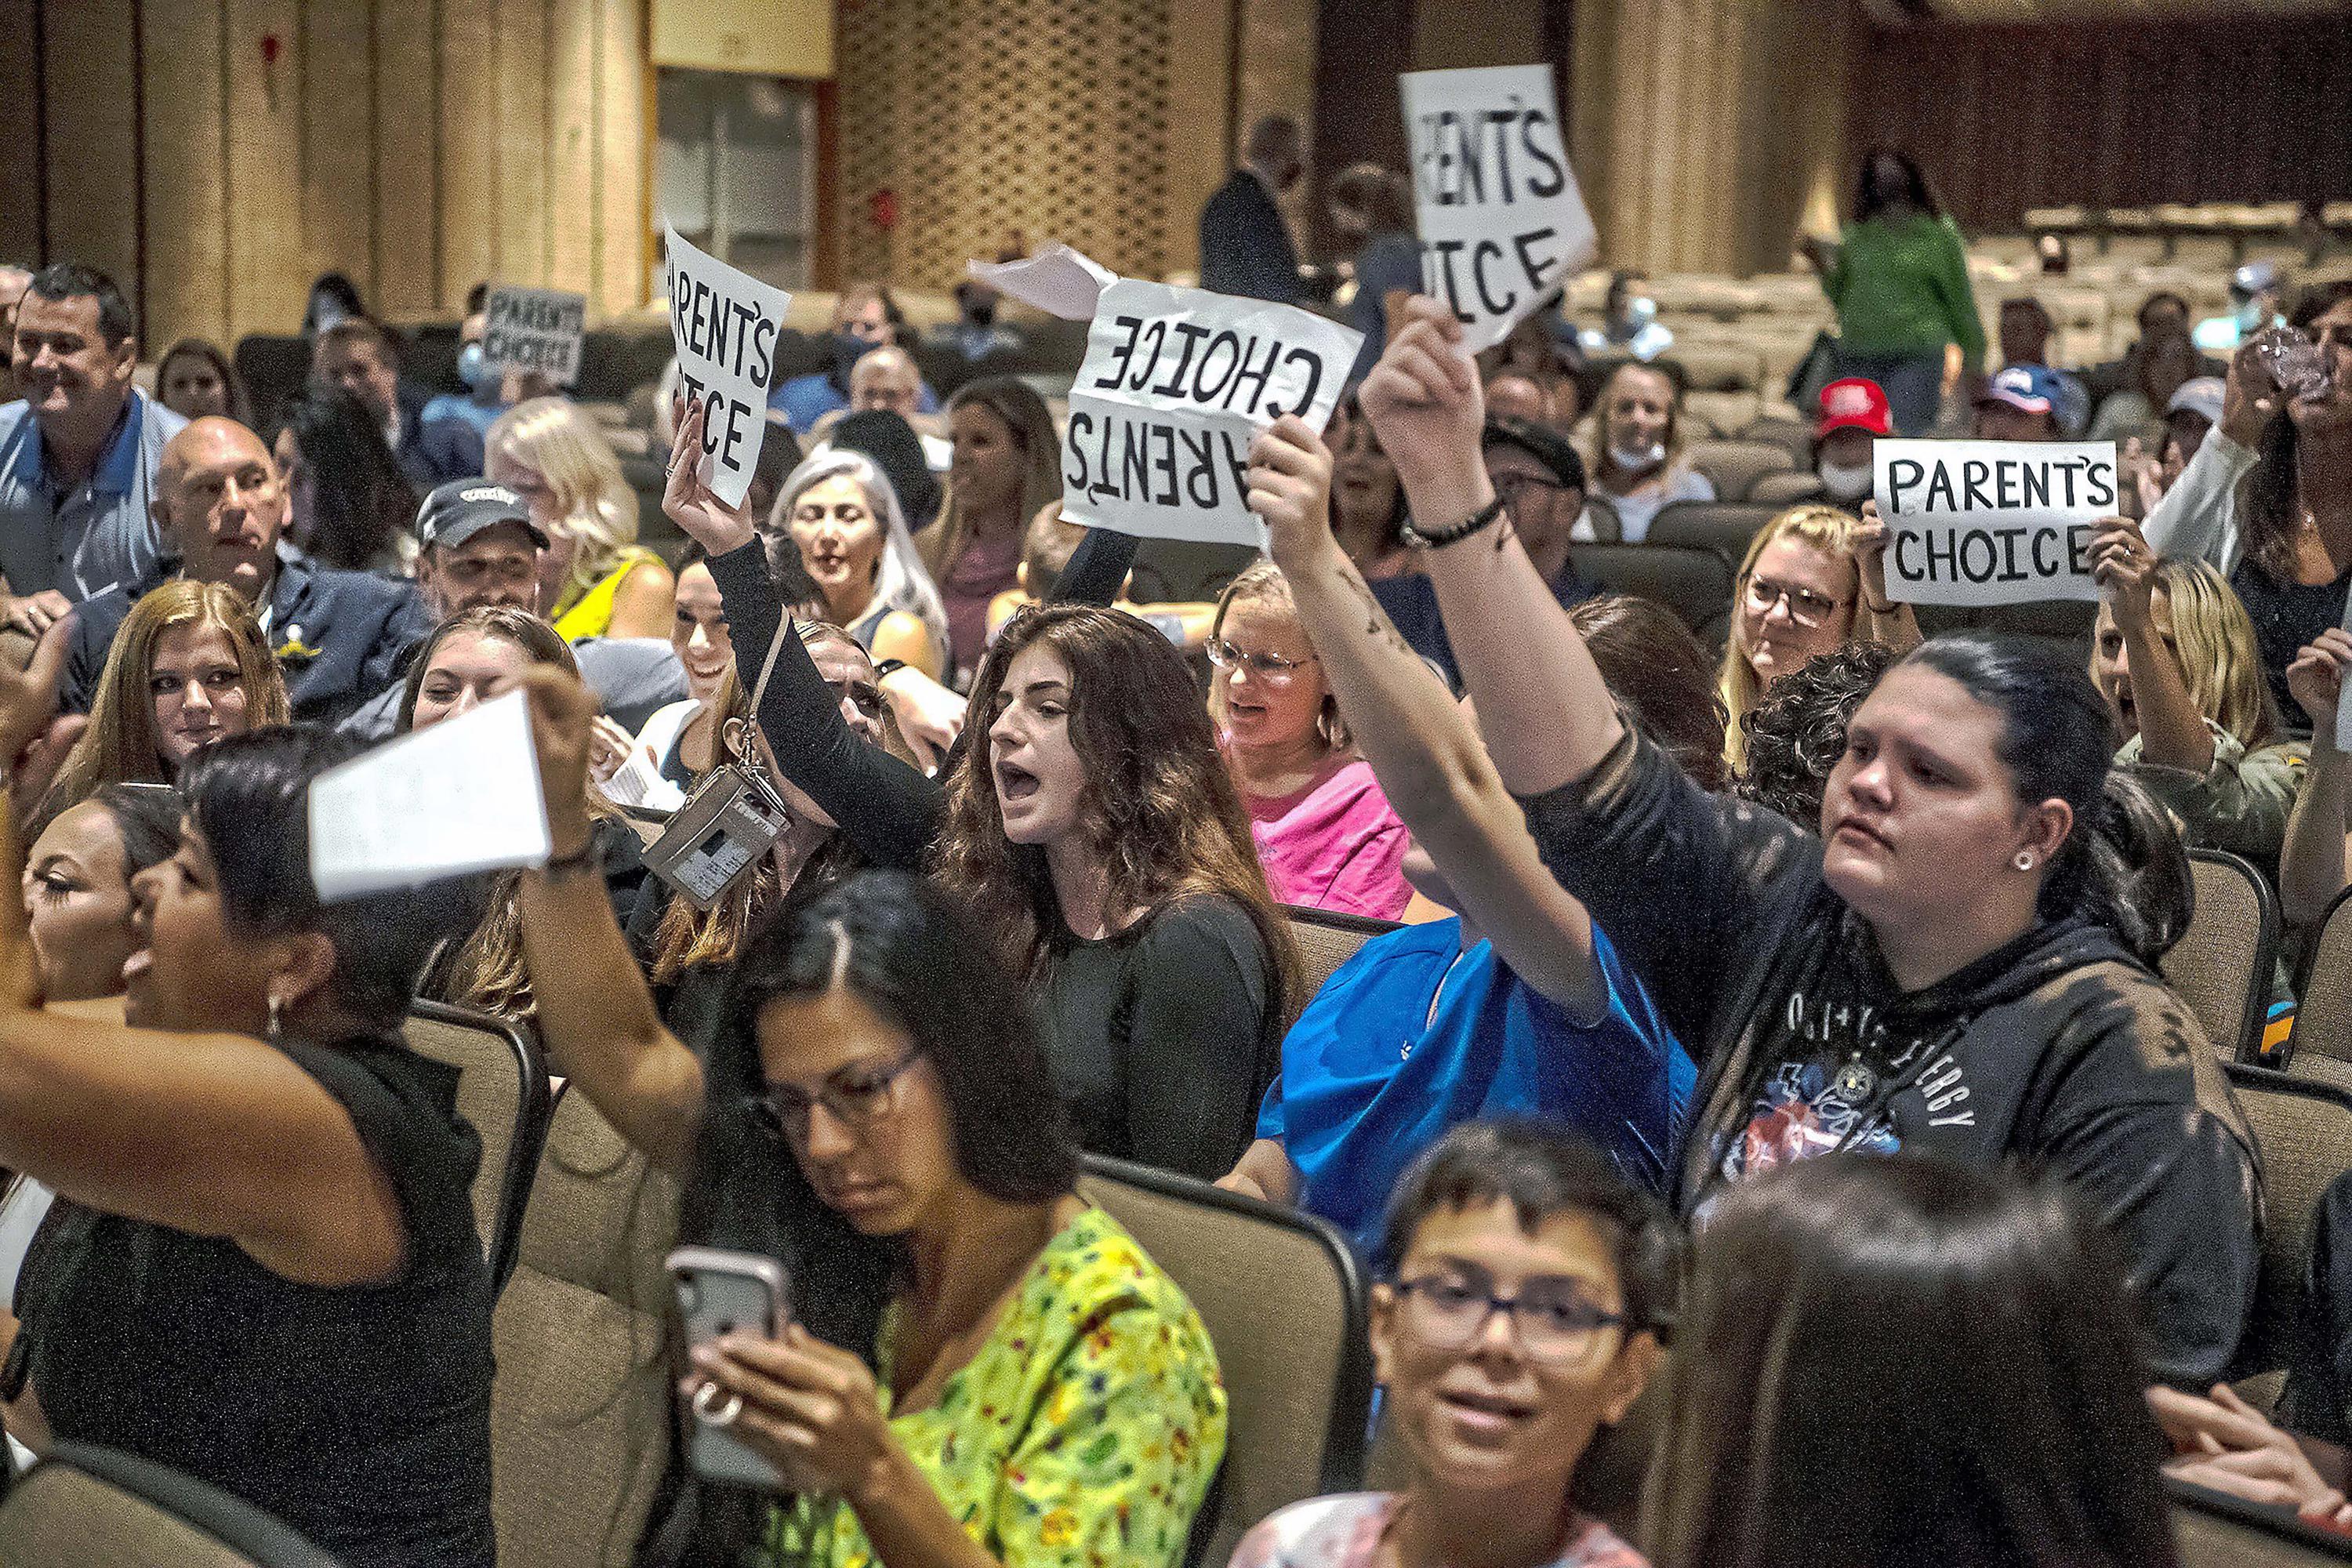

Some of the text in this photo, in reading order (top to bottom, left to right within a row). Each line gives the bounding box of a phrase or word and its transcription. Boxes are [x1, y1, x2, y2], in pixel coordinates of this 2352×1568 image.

[1094, 315, 1323, 419] CHOICE
[1066, 412, 1253, 512] ARENT'S
[1889, 456, 2114, 514] PARENT'S
[1895, 524, 2092, 583] CHOICE
